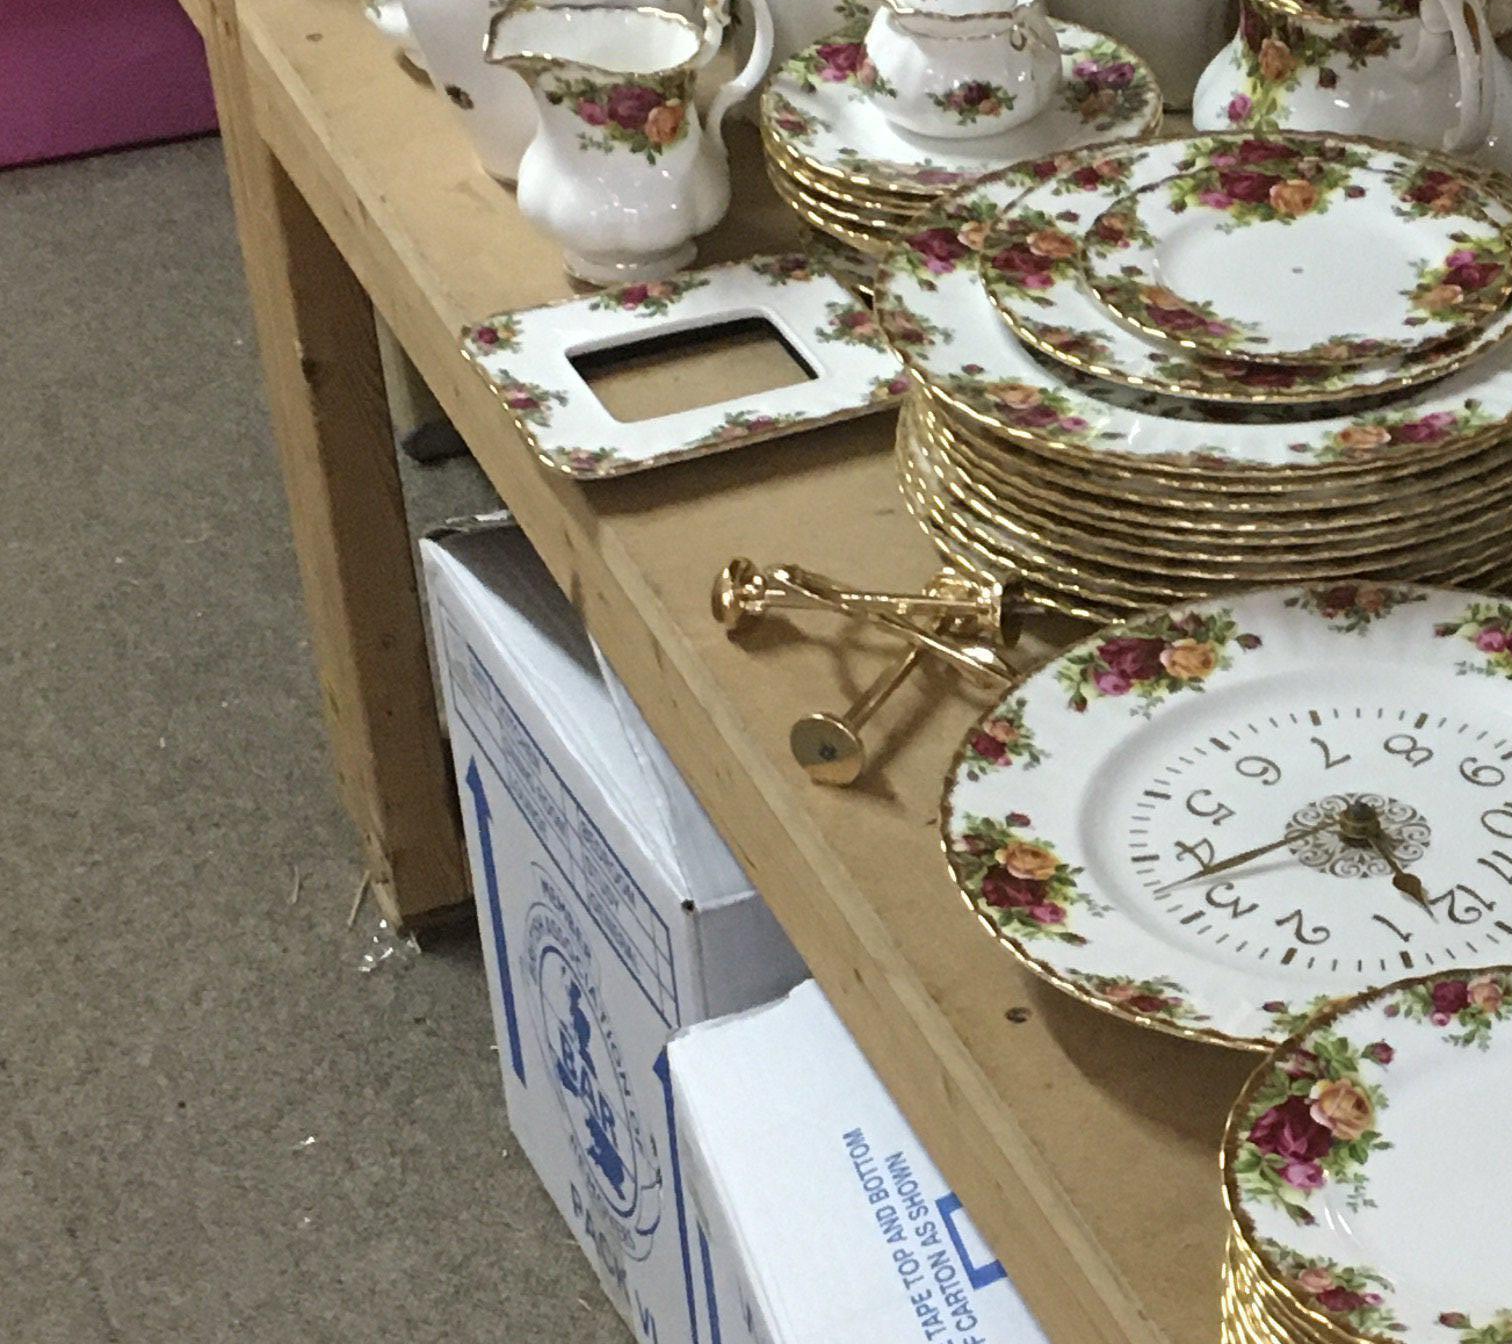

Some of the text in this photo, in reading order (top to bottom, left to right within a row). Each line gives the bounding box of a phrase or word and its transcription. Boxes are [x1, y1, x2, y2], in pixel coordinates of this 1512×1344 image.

[1310, 736, 1352, 770] 7
[1383, 733, 1435, 767] 8
[1235, 755, 1282, 786] 6
[1458, 754, 1506, 789] 9
[1185, 788, 1237, 826] 5
[1174, 836, 1217, 876] 4
[1204, 880, 1260, 921] 3
[1428, 883, 1497, 926] 12
[1274, 908, 1331, 946] 2
[1372, 913, 1414, 944] 1
[558, 1026, 618, 1148] BAR
[842, 1127, 890, 1206] BOTTOM
[885, 1150, 930, 1222] SHOWN
[570, 1180, 632, 1306] PACK
[875, 1204, 907, 1244] AND
[914, 1219, 943, 1249] AS
[892, 1247, 924, 1292] TOP
[928, 1248, 978, 1334] CARTON
[911, 1288, 948, 1342] TAPE
